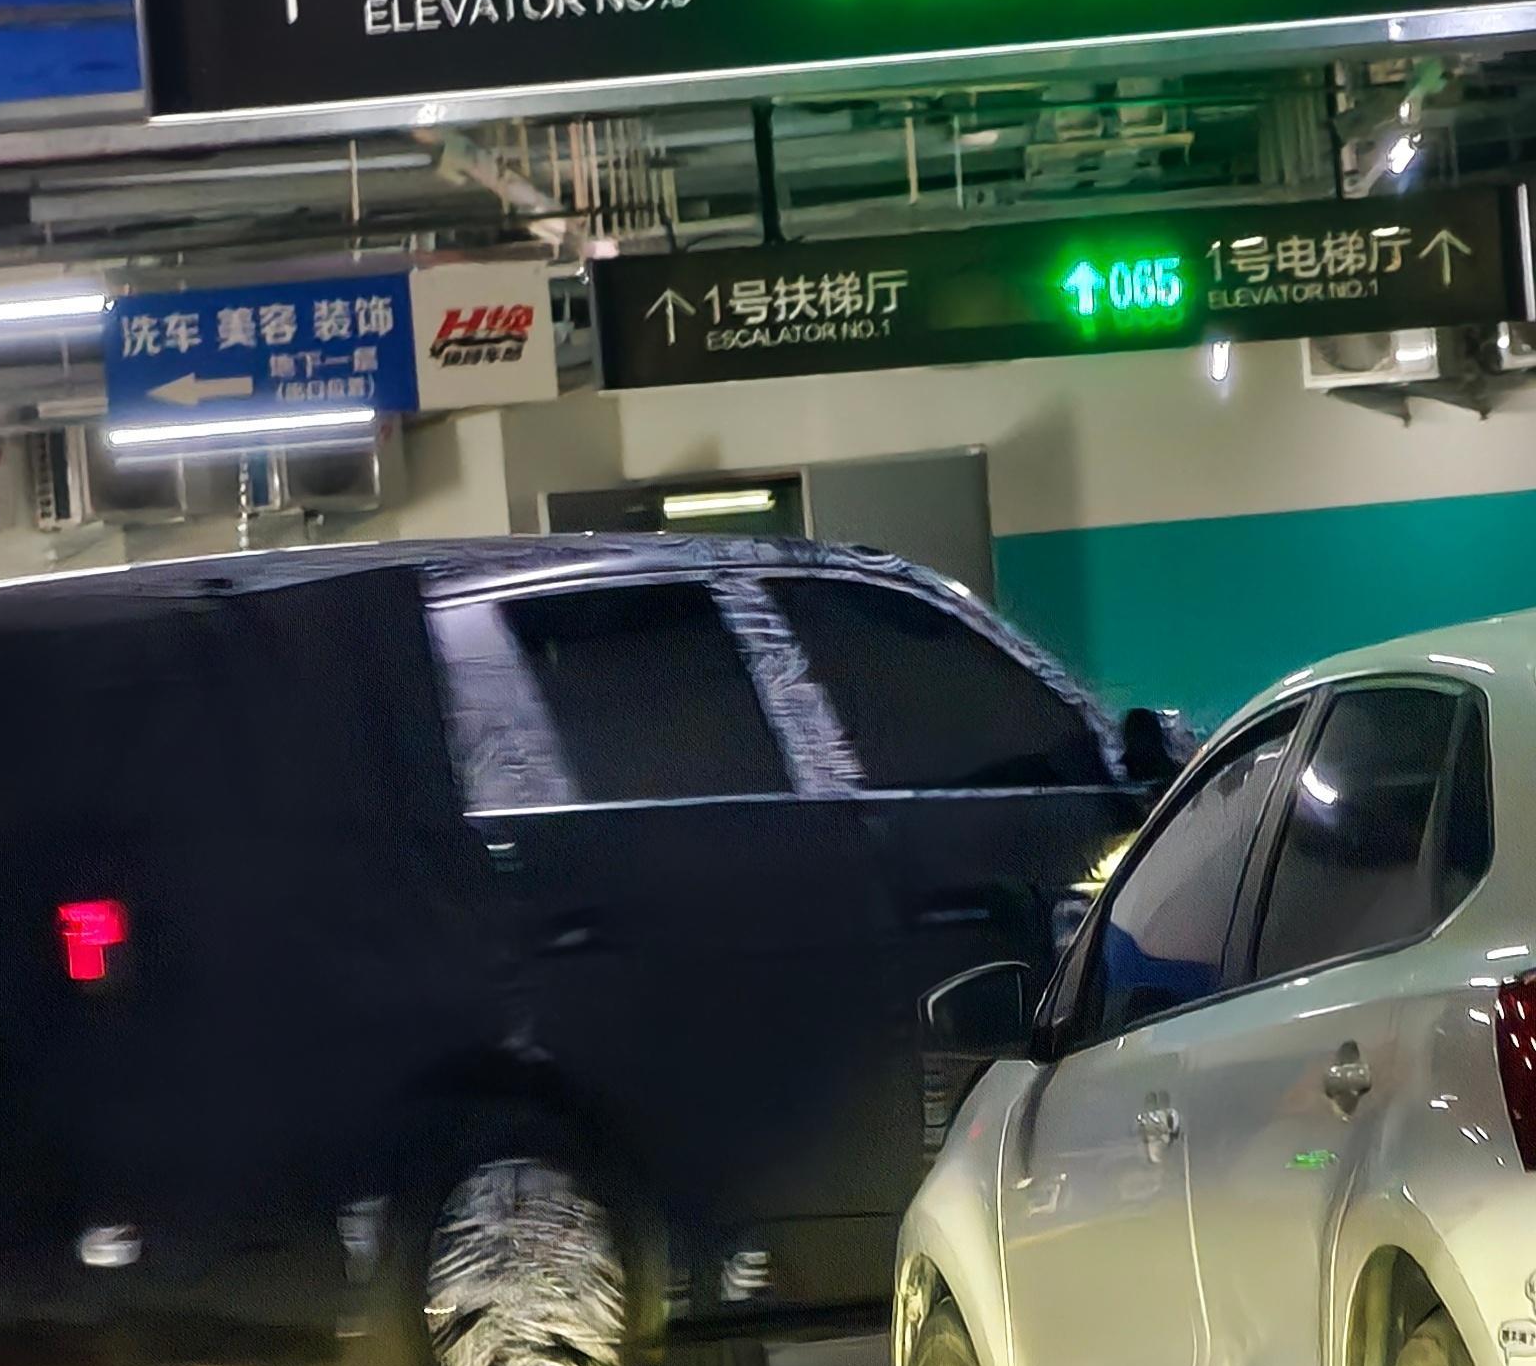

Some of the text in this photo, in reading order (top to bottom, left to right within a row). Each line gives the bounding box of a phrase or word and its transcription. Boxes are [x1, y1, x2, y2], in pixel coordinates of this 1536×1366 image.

[1205, 226, 1413, 283] 1号电梯厅
[703, 270, 908, 326] 1号扶梯厅
[1208, 279, 1379, 311] ELEVATOR NO.1
[121, 313, 202, 358] 洗车
[314, 296, 394, 342] 装饰
[706, 318, 891, 352] ESCALATOR NO.1
